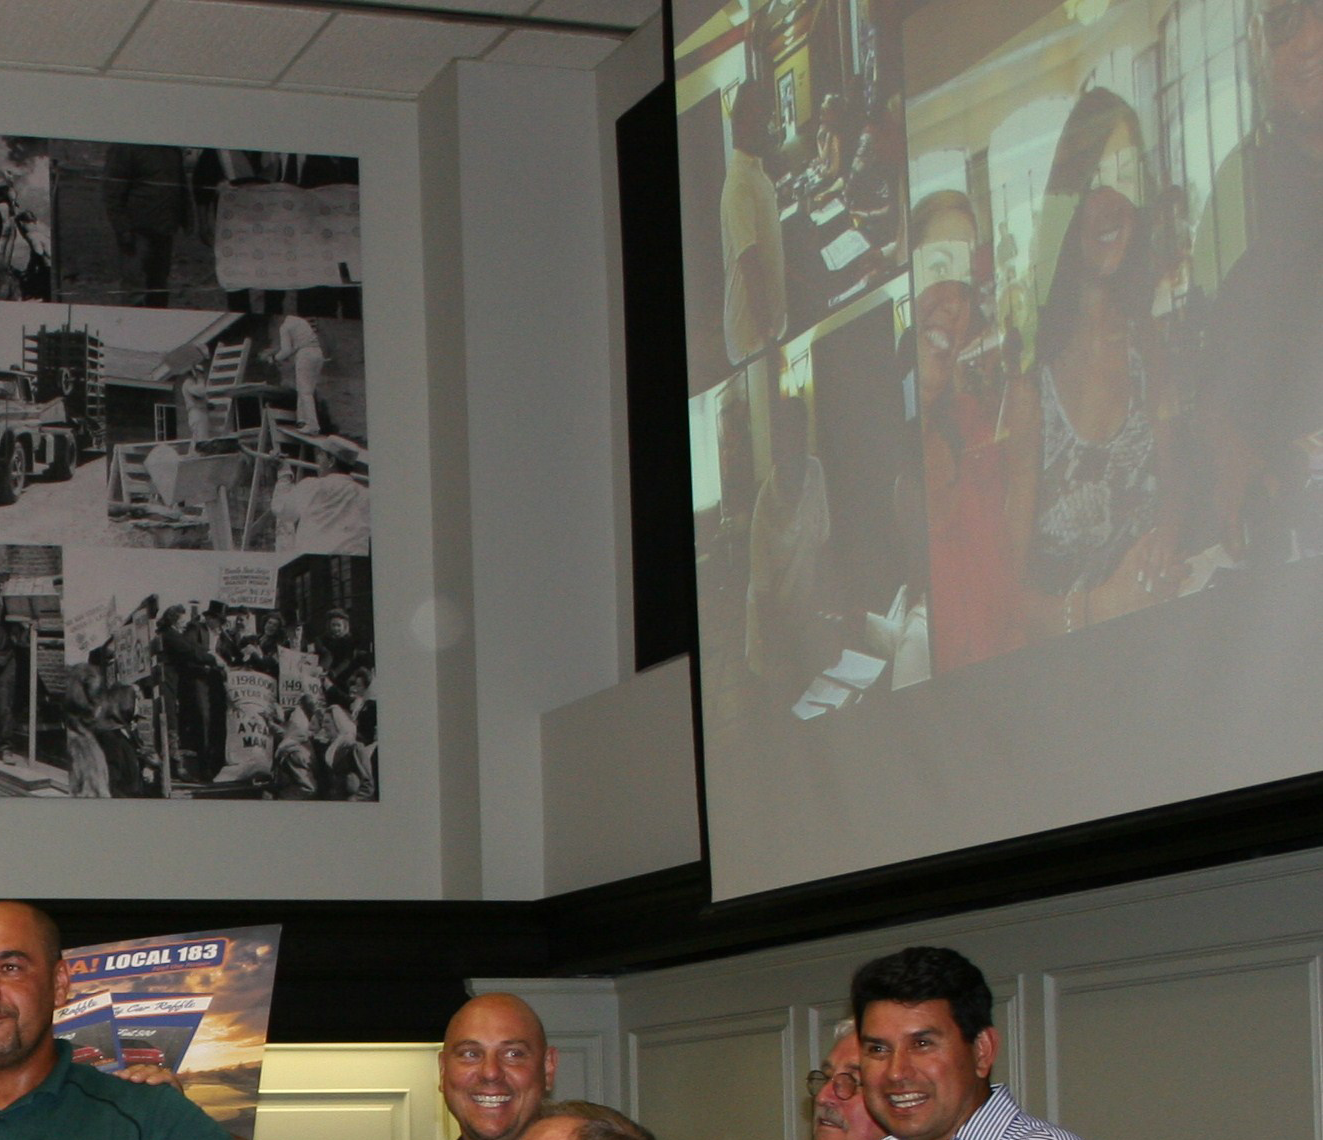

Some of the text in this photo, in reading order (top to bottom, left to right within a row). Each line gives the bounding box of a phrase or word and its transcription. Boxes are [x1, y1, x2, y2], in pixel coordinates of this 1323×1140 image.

[105, 949, 171, 972] LOCAL
[177, 943, 219, 962] 183
[156, 1000, 196, 1014] Raffle
